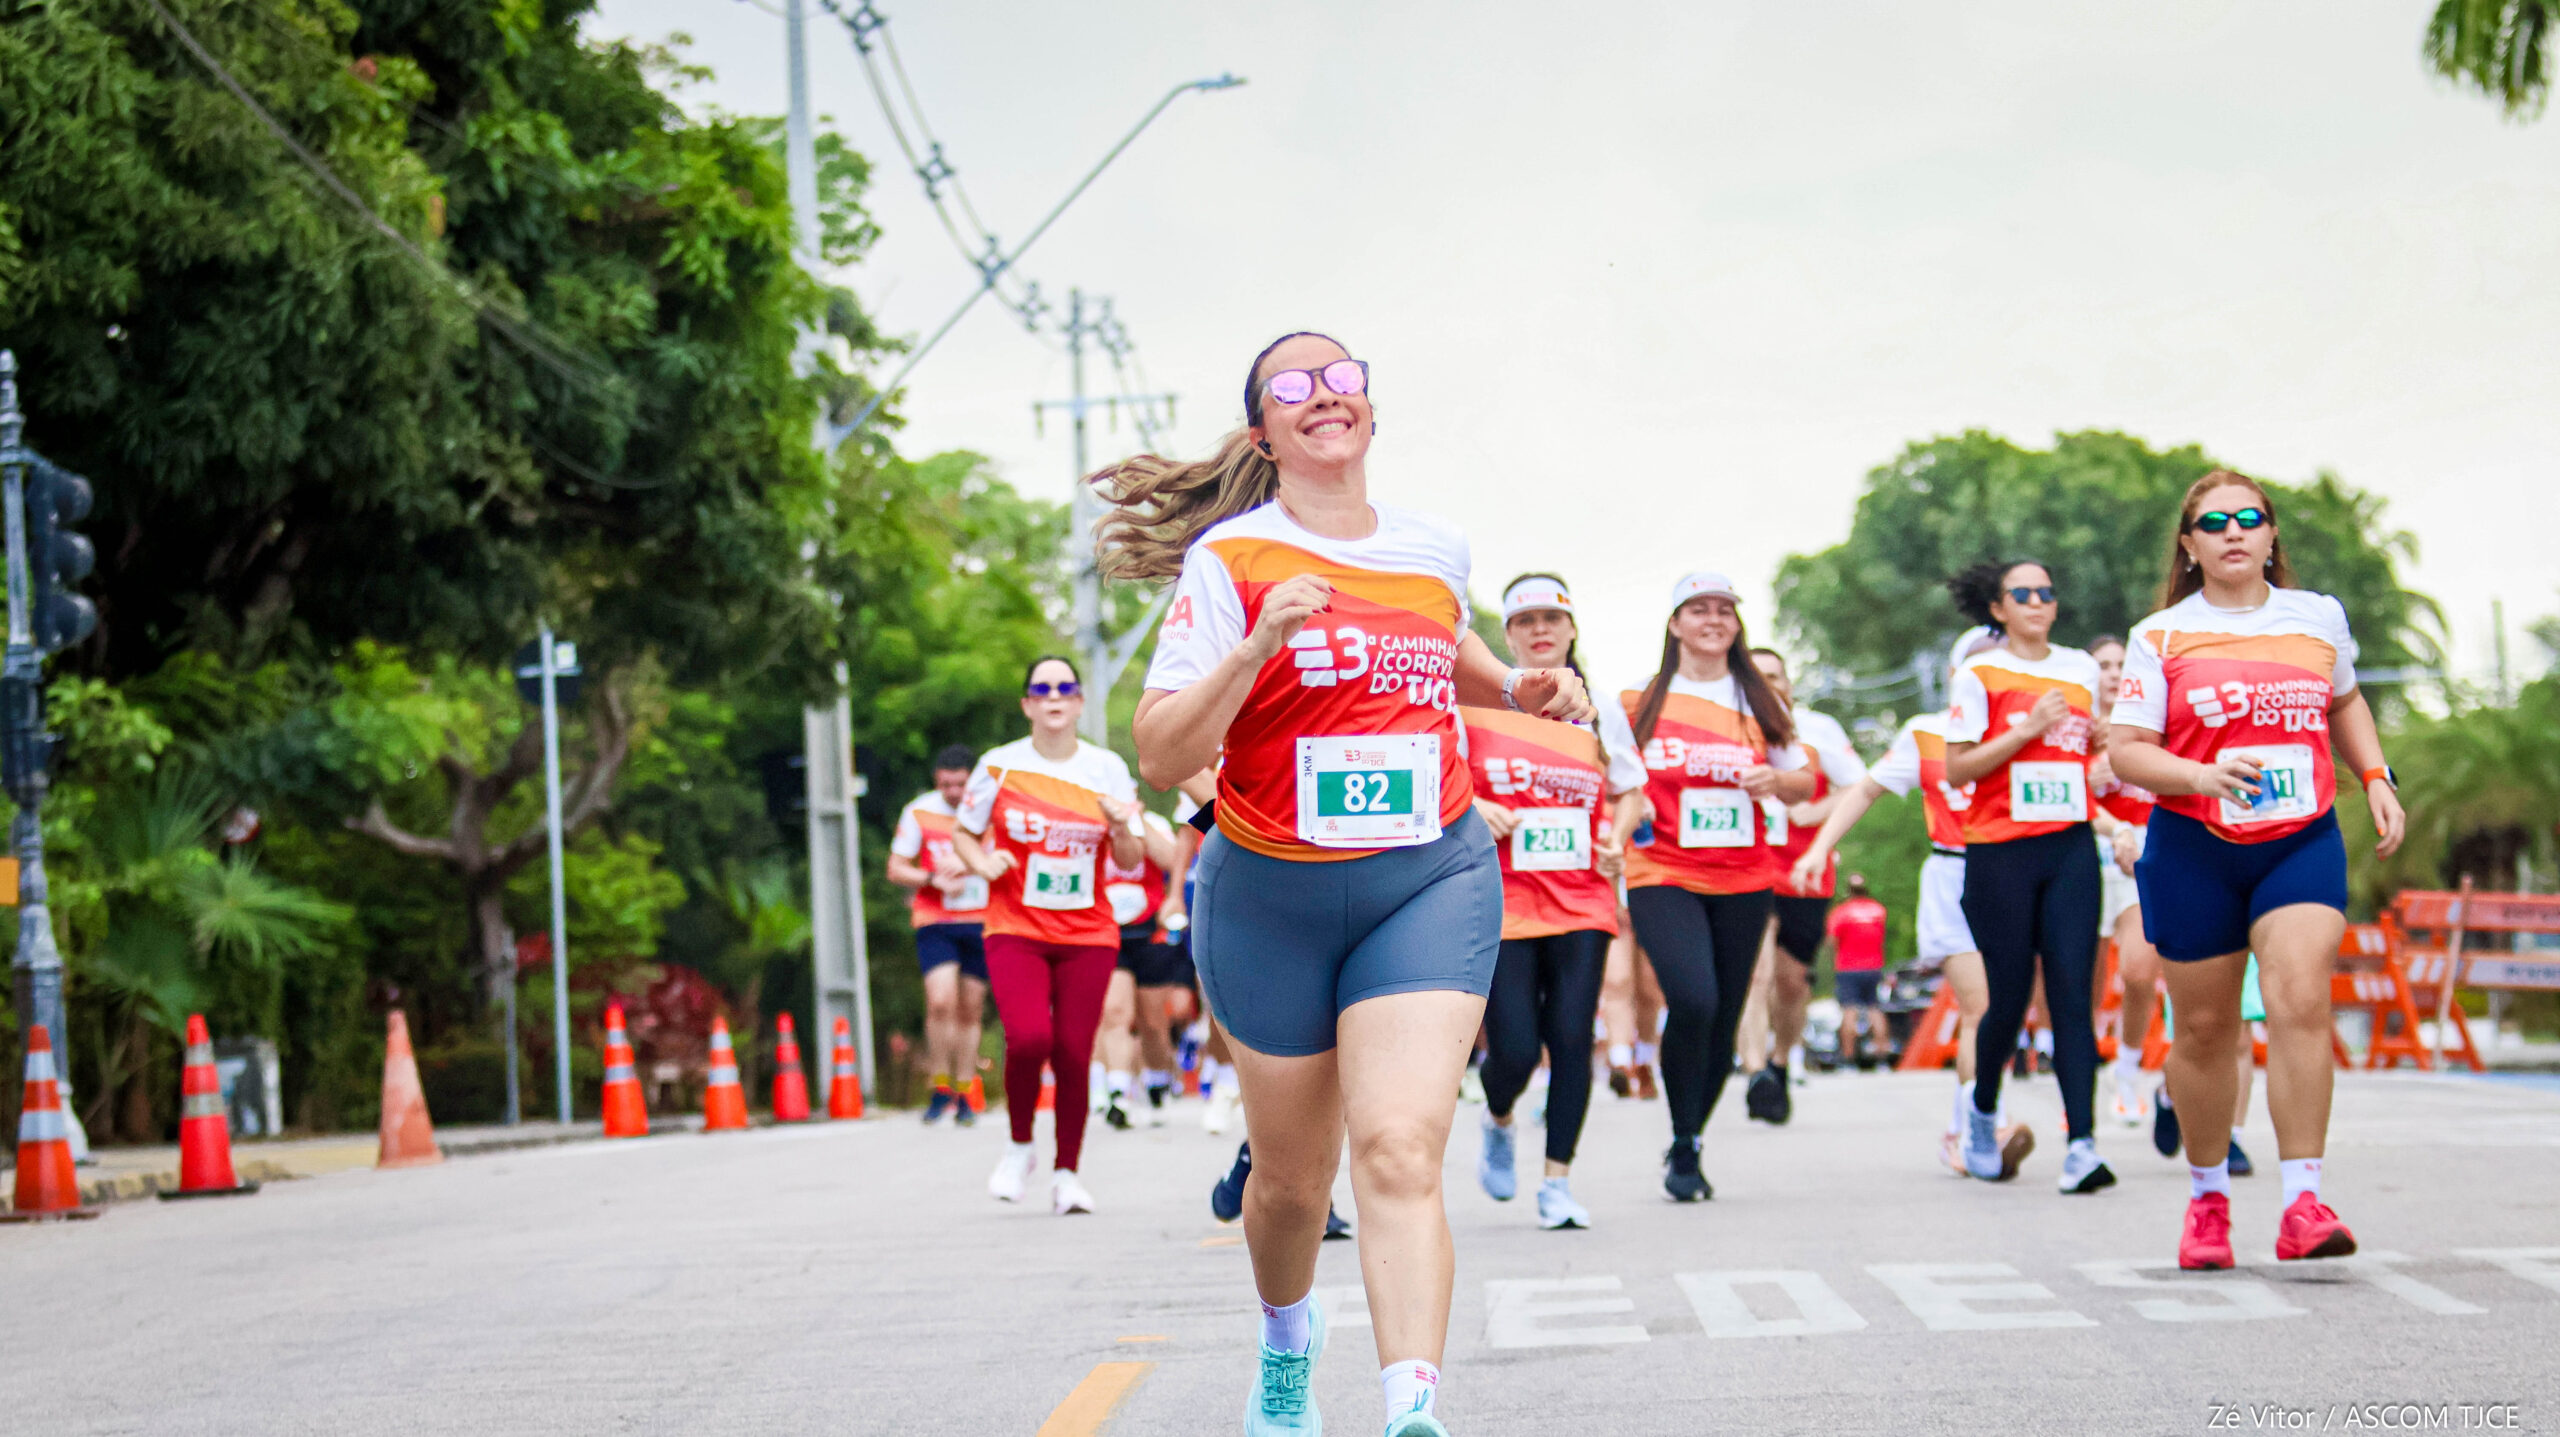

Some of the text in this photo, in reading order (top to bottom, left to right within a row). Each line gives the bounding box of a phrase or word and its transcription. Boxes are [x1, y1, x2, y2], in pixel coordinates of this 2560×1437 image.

[1380, 635, 1458, 660] CAMINHAD
[1369, 672, 1457, 713] DO TJCE
[2252, 707, 2327, 733] DO TJCE
[1304, 755, 1313, 778] 3KM
[1710, 764, 1744, 785] TJC
[1343, 772, 1391, 813] 82
[2029, 782, 2067, 804] 139
[1697, 808, 1735, 830] 799
[1529, 829, 1571, 852] 240
